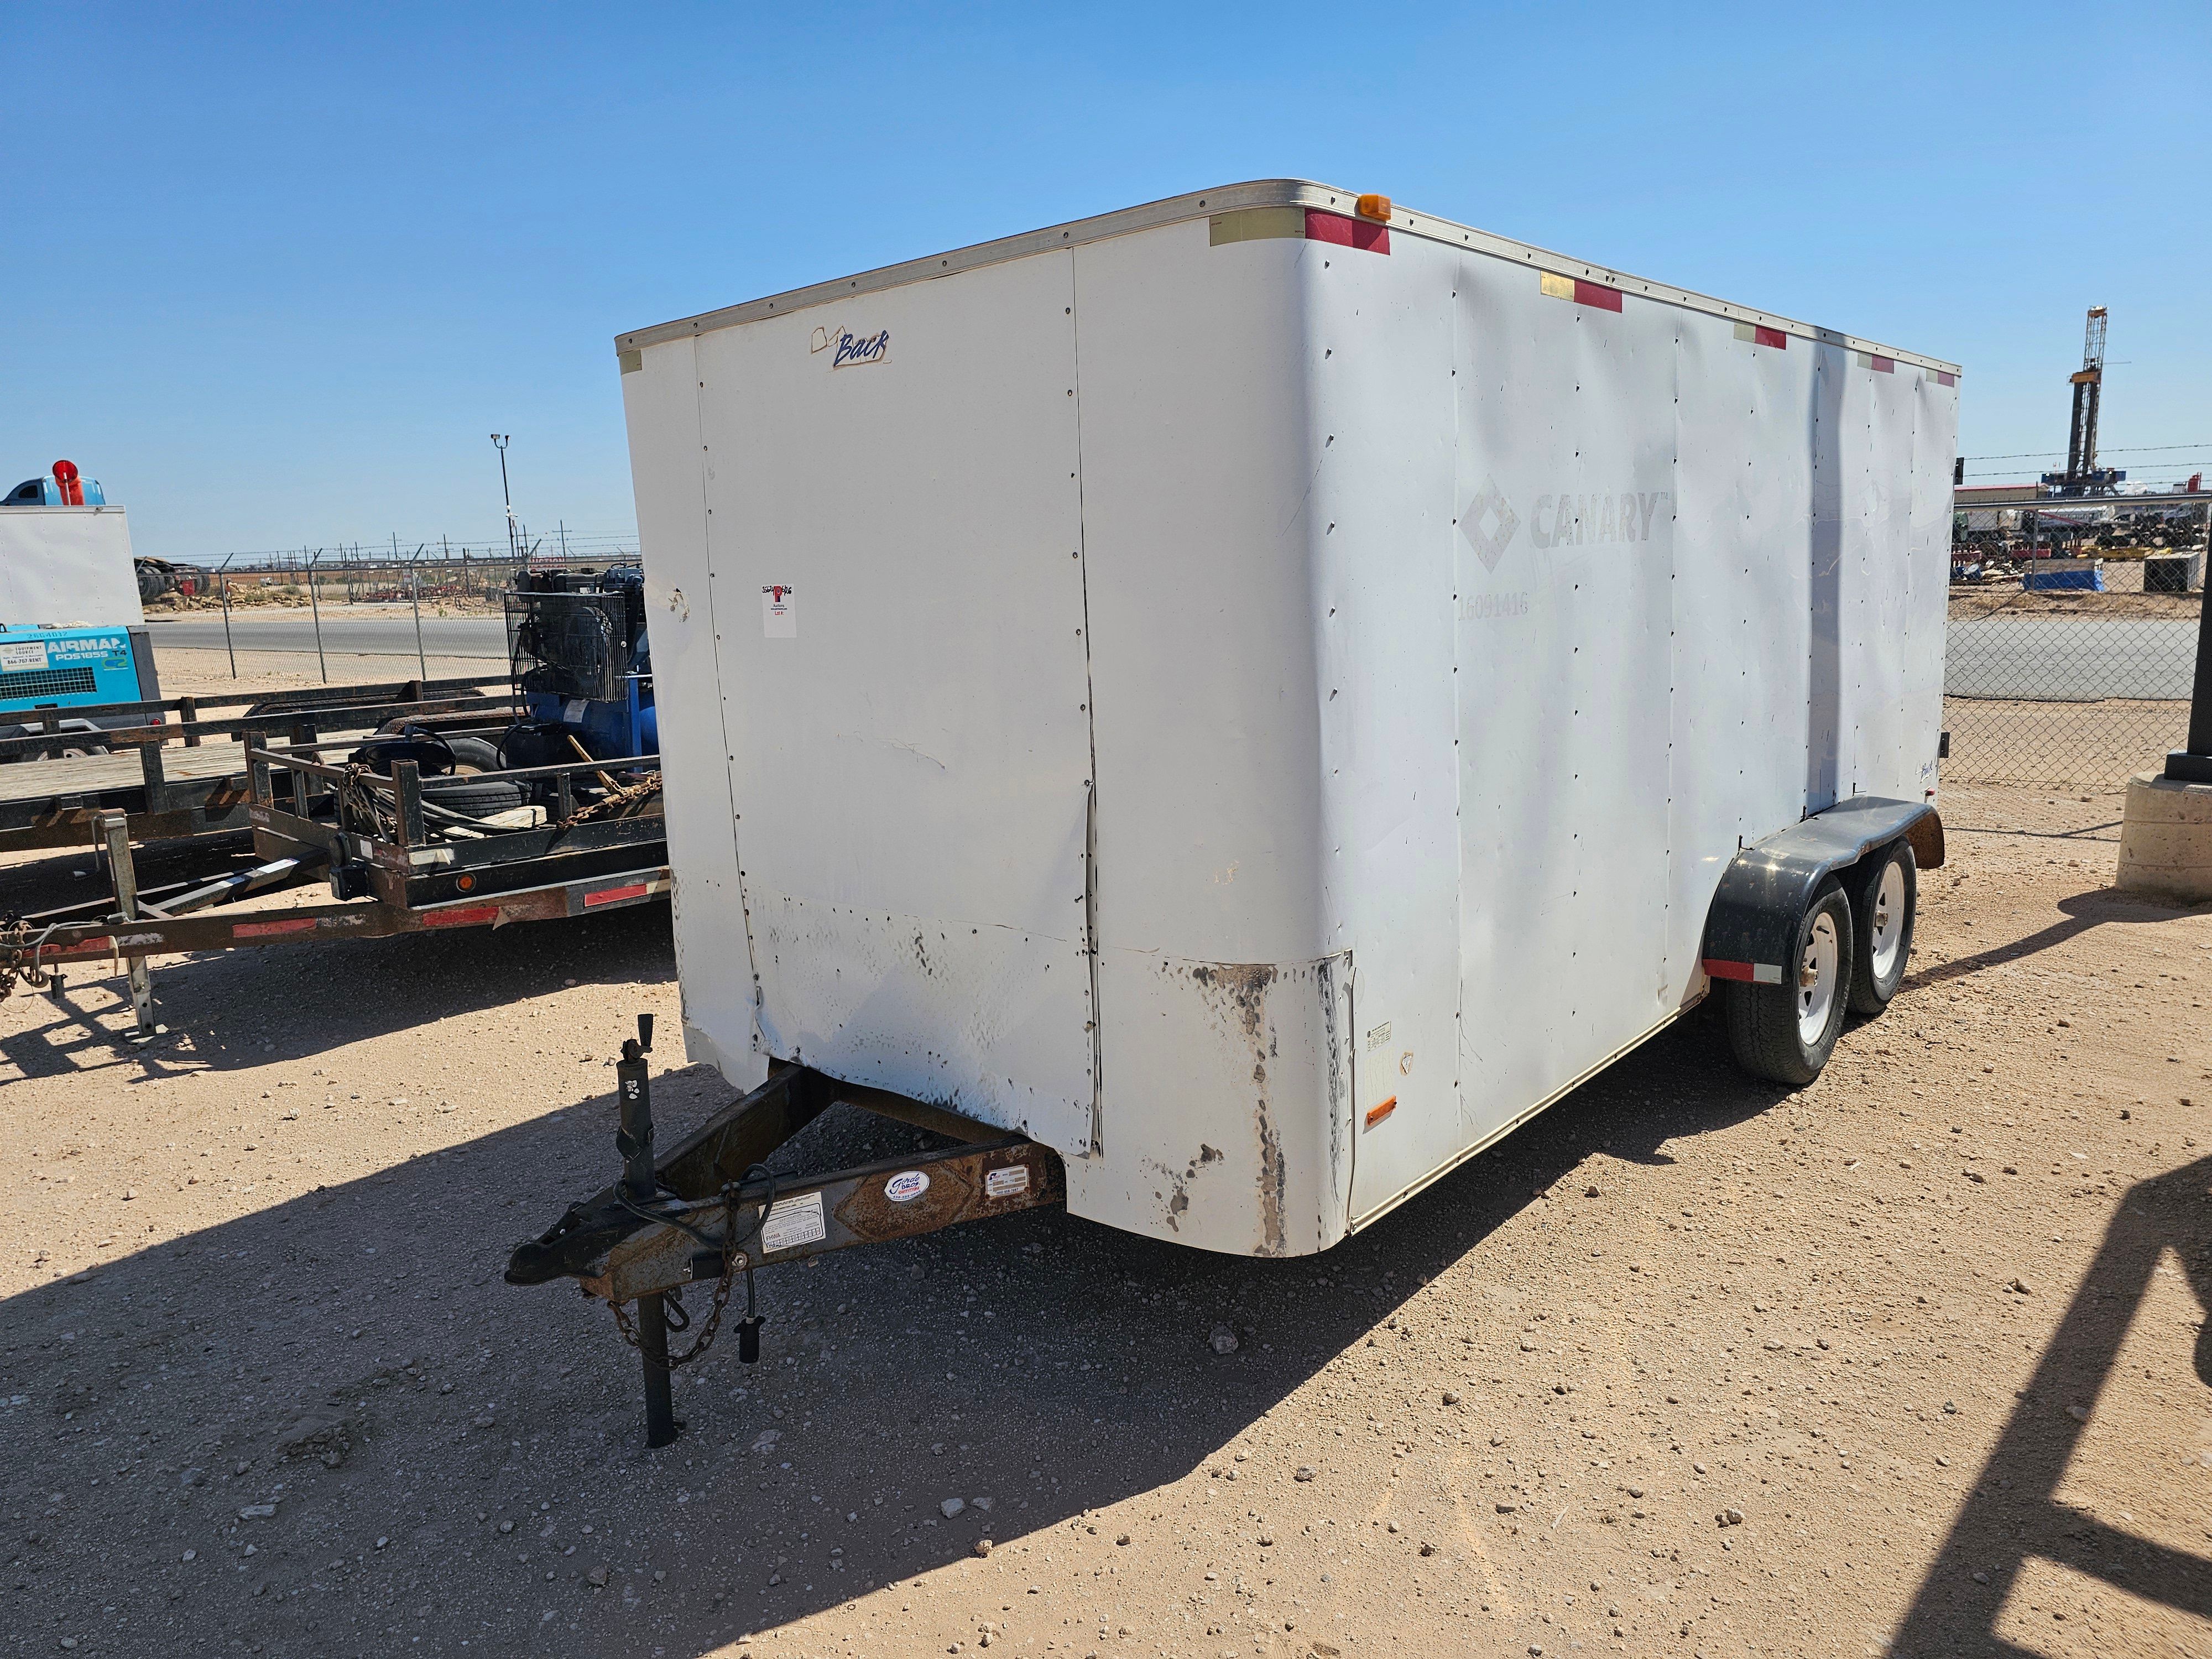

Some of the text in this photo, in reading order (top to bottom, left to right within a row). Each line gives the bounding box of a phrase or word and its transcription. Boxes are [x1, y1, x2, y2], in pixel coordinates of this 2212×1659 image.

[833, 330, 889, 367] Back
[1530, 492, 1659, 550] CANARY
[1458, 591, 1528, 620] 16091416
[55, 651, 109, 661] PDS185S
[889, 1173, 920, 1194] Gordo
[766, 1233, 781, 1241] FHWA
